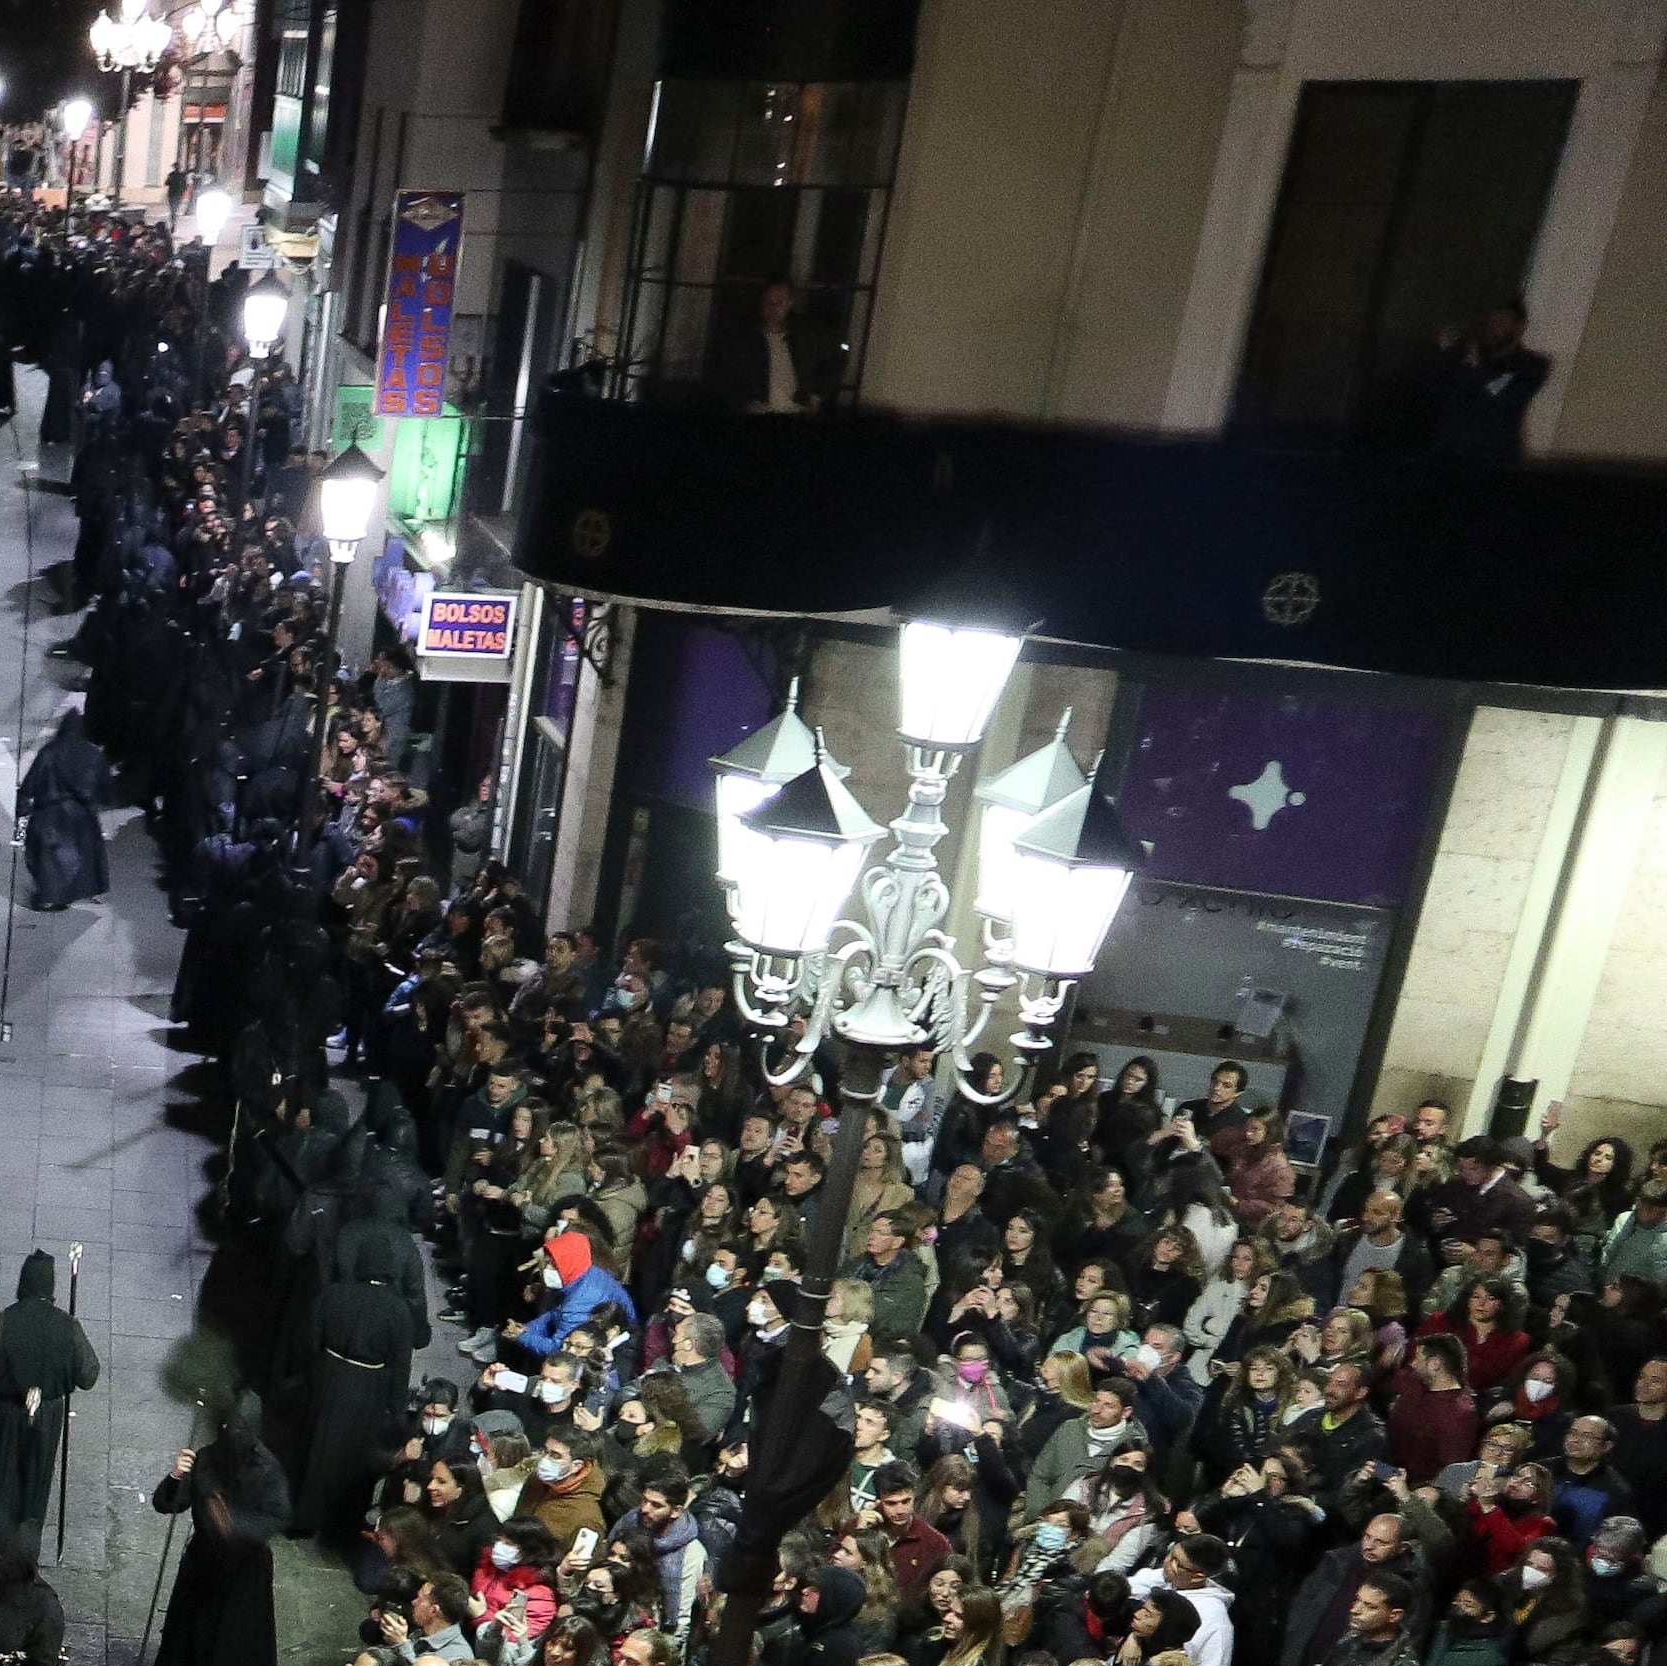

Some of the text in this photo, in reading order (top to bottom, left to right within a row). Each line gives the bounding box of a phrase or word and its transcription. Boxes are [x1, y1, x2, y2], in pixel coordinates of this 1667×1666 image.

[382, 255, 420, 413] MALETAS
[411, 253, 455, 414] BOLSOS
[427, 629, 505, 650] MALETAS
[432, 603, 505, 624] BOLSOS
